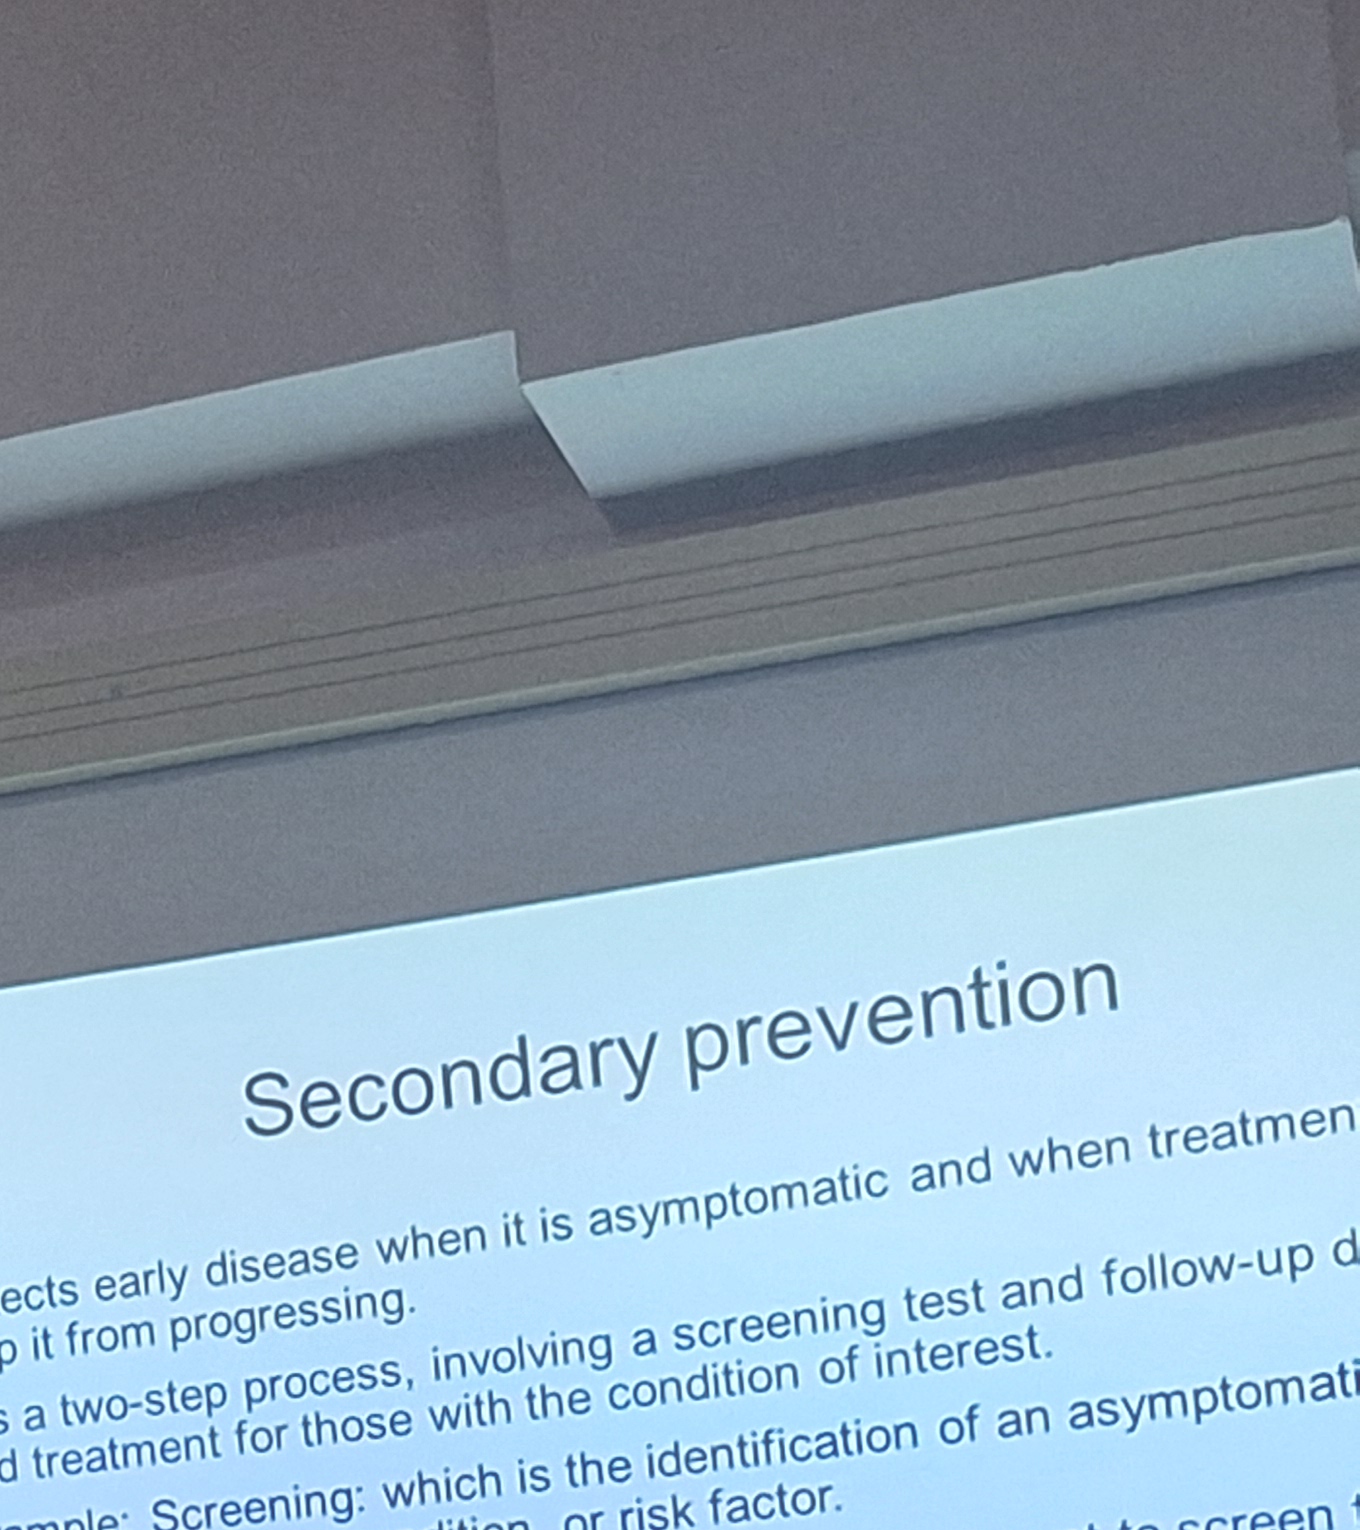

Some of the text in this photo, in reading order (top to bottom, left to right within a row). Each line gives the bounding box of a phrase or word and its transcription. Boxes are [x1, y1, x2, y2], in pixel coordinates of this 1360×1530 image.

[243, 958, 1120, 1139] Secondary prevention
[93, 1257, 190, 1304] early
[204, 1241, 361, 1289] disease
[374, 1222, 489, 1267] when
[500, 1210, 529, 1250] it
[538, 1204, 575, 1245] is
[587, 1161, 891, 1242] asymptomatic
[909, 1143, 993, 1194] and
[1006, 1134, 1133, 1180] when
[22, 1403, 48, 1434] a
[58, 1378, 229, 1429] two-step
[242, 1359, 416, 1416] process,
[430, 1328, 614, 1384] involving
[630, 1326, 660, 1358] a
[671, 1294, 888, 1353] screening
[901, 1277, 988, 1324] test
[1000, 1261, 1085, 1312] and
[1099, 1242, 1316, 1298] follow-up
[29, 1324, 57, 1364] it
[63, 1318, 157, 1358] from
[168, 1283, 418, 1355] progressing.
[30, 1423, 224, 1481] treatment
[232, 1417, 291, 1457] for
[299, 1408, 415, 1450] those
[426, 1387, 514, 1434] with
[523, 1381, 593, 1422] the
[606, 1356, 801, 1412] condition
[818, 1342, 862, 1386] of
[872, 1322, 1055, 1381] interest.
[380, 1461, 505, 1512] which
[516, 1456, 553, 1496] is
[562, 1449, 635, 1490] the
[644, 1416, 921, 1481] identification
[937, 1401, 983, 1447] of
[996, 1404, 1052, 1441] an
[705, 1480, 844, 1528] factor.
